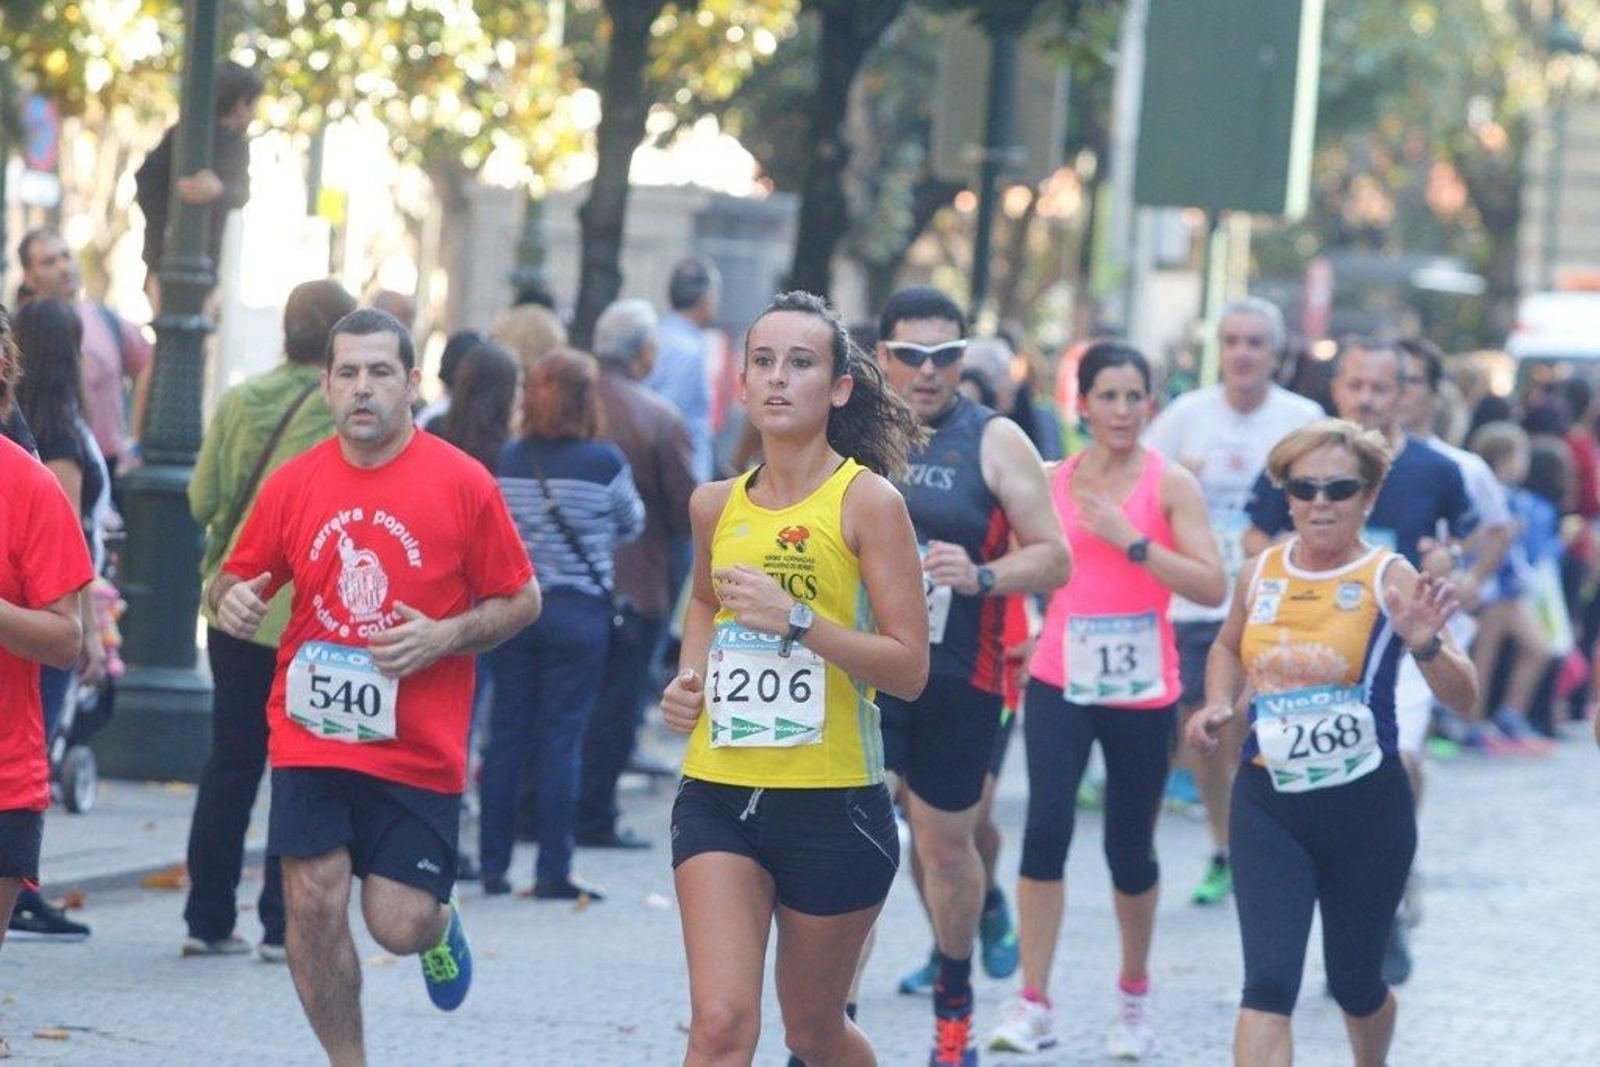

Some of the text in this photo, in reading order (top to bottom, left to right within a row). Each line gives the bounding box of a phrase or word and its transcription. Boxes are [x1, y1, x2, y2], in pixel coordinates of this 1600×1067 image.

[310, 507, 422, 568] carreira popular
[766, 572, 817, 601] ICS
[339, 624, 350, 638] e
[1095, 643, 1137, 676] 13
[309, 674, 381, 717] 540
[712, 667, 812, 703] 1206
[1283, 713, 1361, 760] 268
